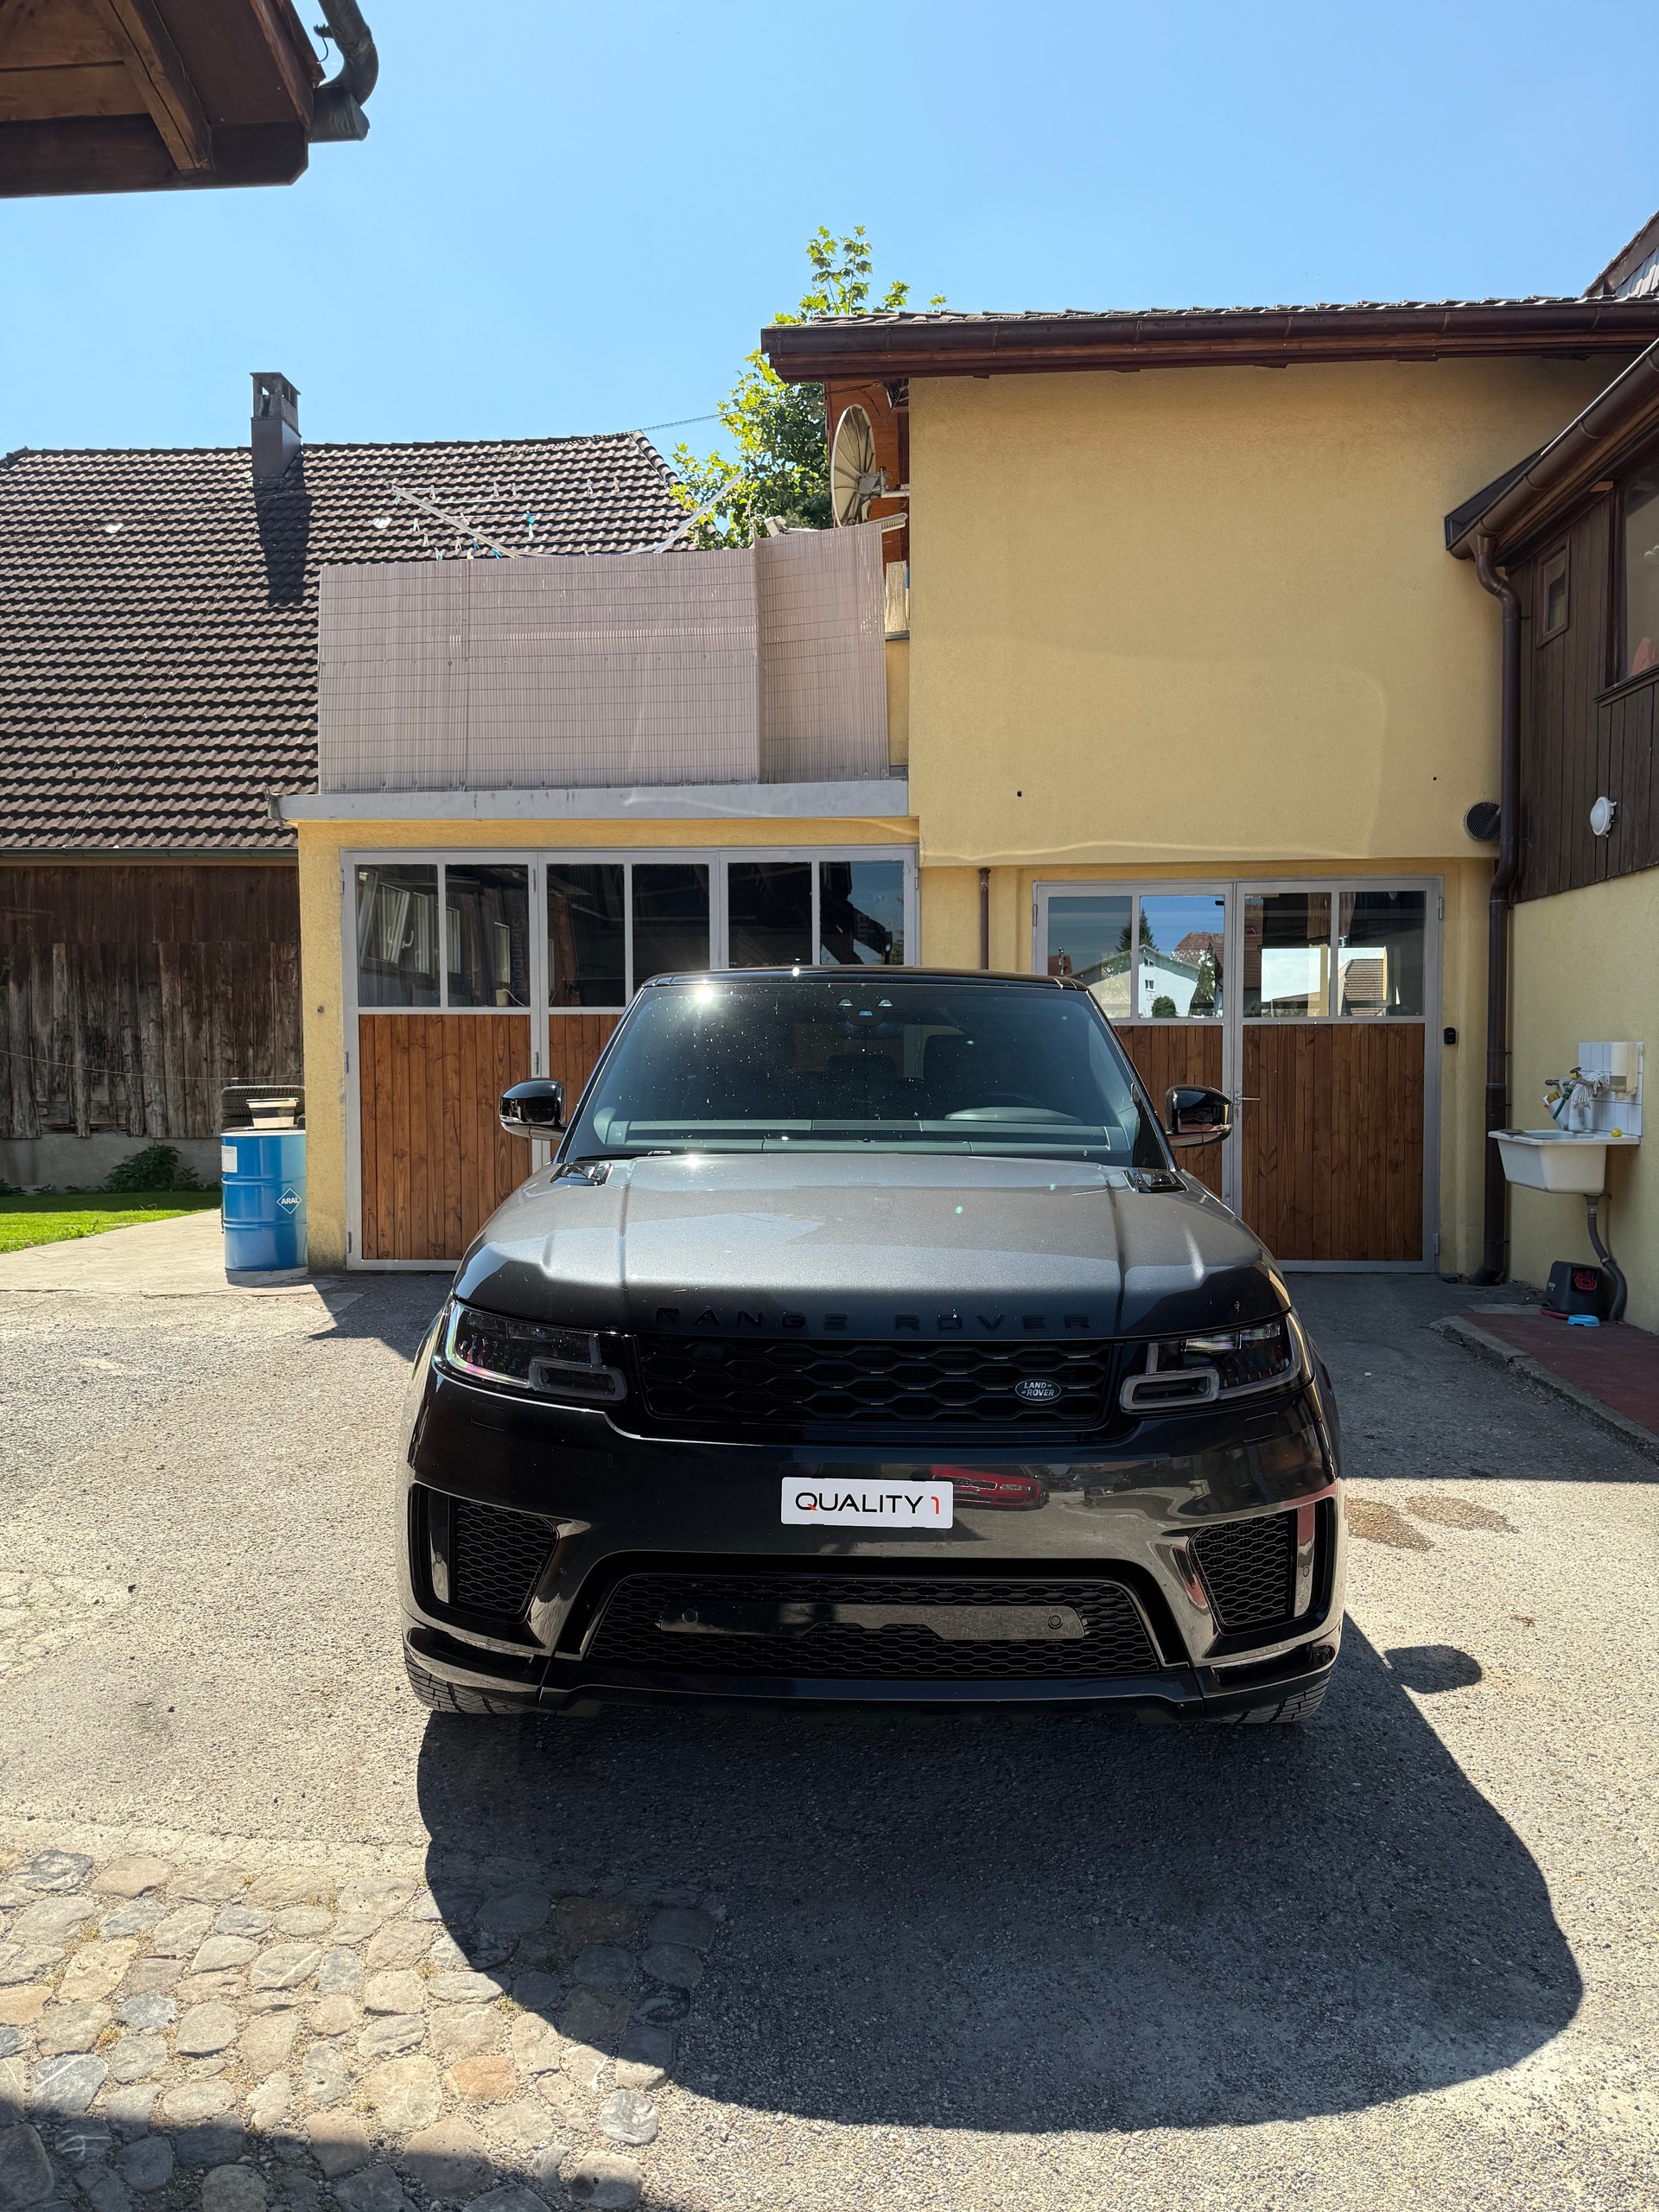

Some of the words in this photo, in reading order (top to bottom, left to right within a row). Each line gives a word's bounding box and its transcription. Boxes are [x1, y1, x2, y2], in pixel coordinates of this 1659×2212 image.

[281, 1197, 300, 1205] ARAL
[655, 1306, 848, 1331] RANGE
[894, 1313, 1090, 1332] ROVER
[795, 1491, 924, 1514] QUALITY
[931, 1496, 940, 1515] 1
